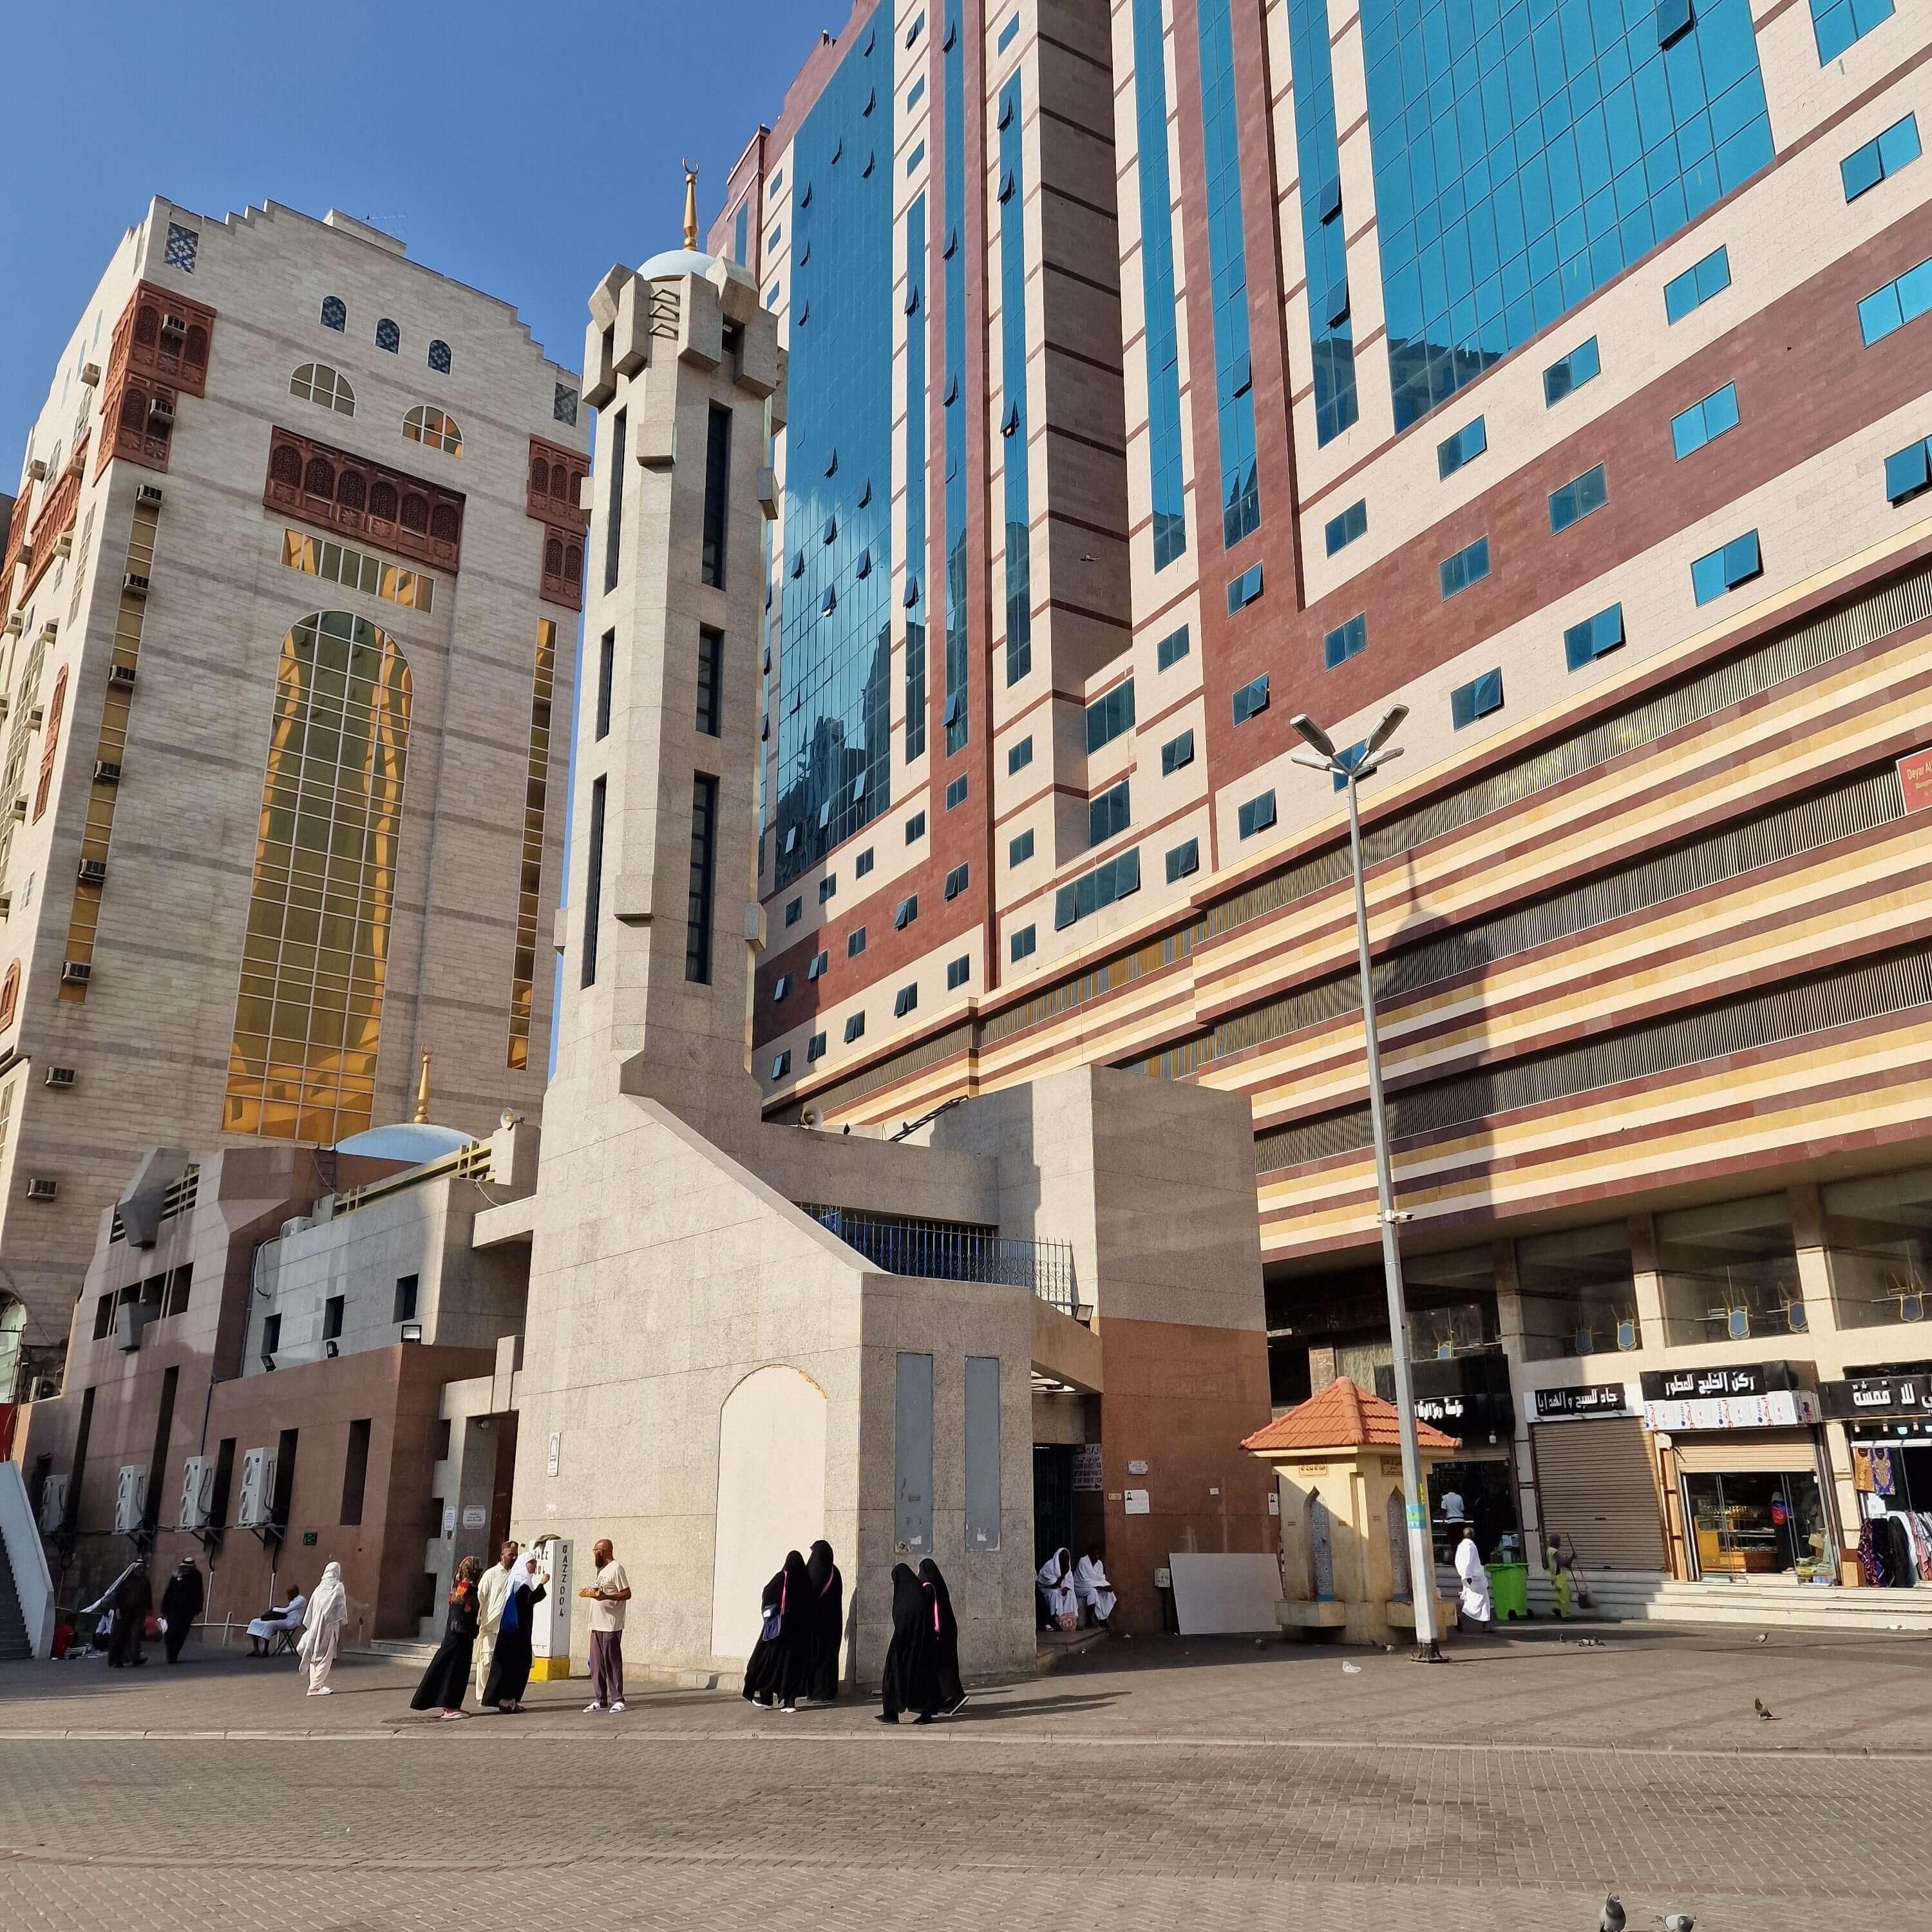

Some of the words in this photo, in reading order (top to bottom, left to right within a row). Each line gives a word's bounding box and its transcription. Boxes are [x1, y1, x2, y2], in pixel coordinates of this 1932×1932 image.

[1665, 1374, 1694, 1396] للعطور
[1698, 1372, 1728, 1395] الخليج
[1731, 1370, 1756, 1392] ركن
